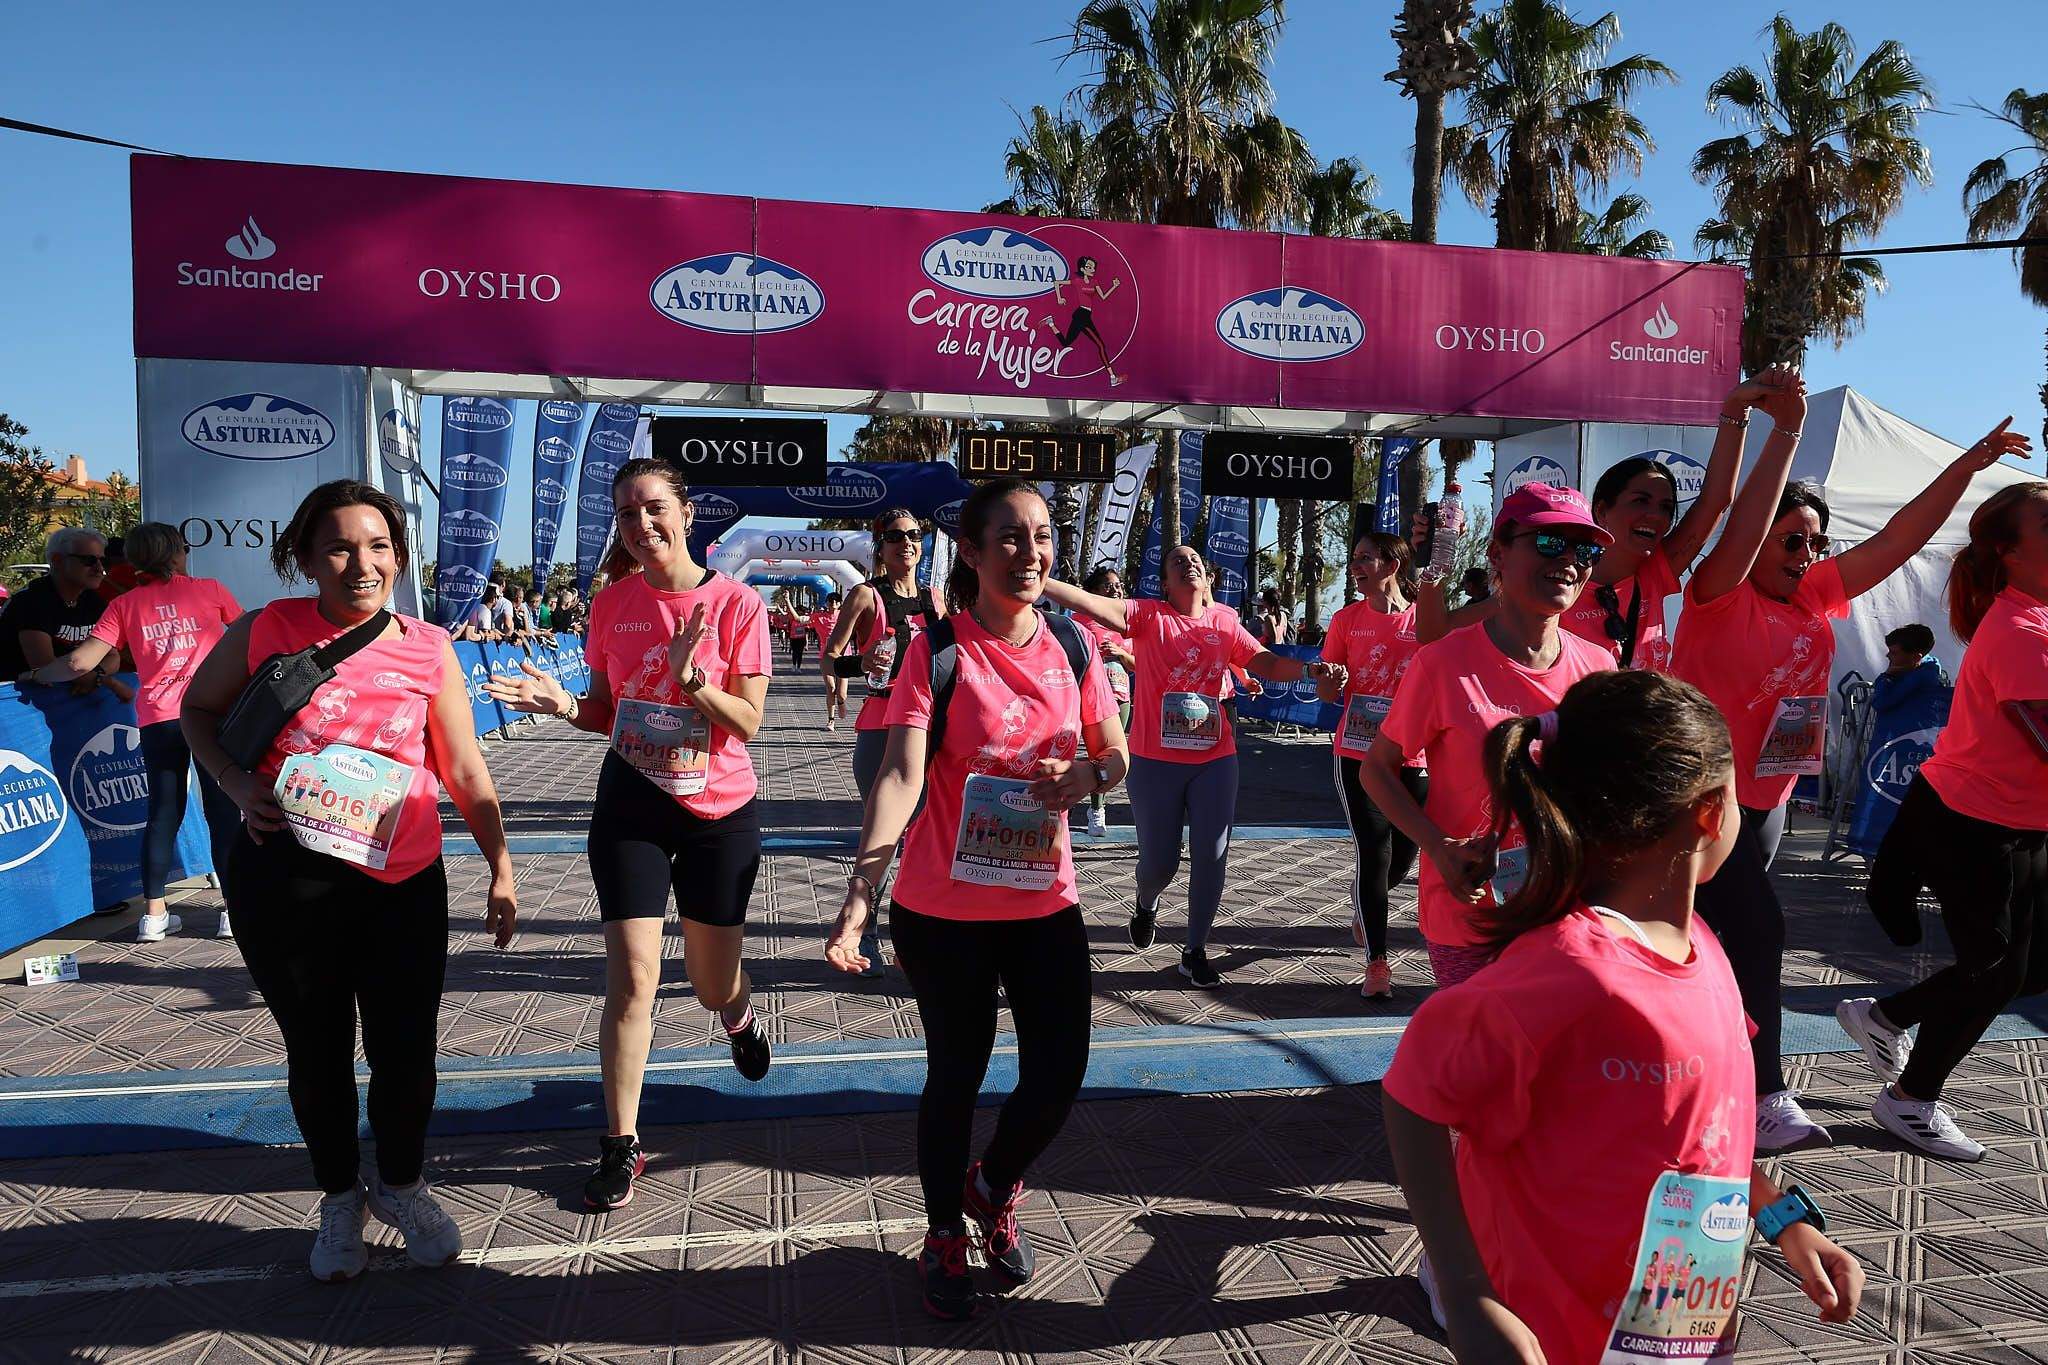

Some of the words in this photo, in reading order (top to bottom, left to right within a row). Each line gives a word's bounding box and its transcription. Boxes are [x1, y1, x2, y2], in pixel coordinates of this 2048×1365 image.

[956, 249, 1003, 260] CENTRAL
[1008, 252, 1054, 262] LECHERA
[177, 262, 324, 292] Santander
[933, 250, 1057, 283] ASTURIANA
[418, 268, 561, 302] OYSHO
[691, 279, 746, 289] CENTRAL
[664, 279, 811, 315] ASTURIANA
[907, 288, 1029, 332] Carrera
[1302, 313, 1350, 323] LECHERA
[1228, 311, 1353, 344] ASTURIANA
[1435, 325, 1545, 354] OYSHO
[937, 329, 960, 355] de
[965, 330, 981, 356] la
[977, 329, 1074, 389] Mujer
[1609, 341, 1709, 365] Santander
[194, 416, 325, 445] ASTURIANA
[217, 415, 266, 425] CENTRAL
[270, 417, 319, 426] LECHERA
[681, 438, 804, 466] OYSHO
[970, 438, 1104, 472] 00:57:11
[1227, 453, 1332, 480] OYSHO
[179, 517, 292, 548] OYSH
[765, 535, 845, 553] OYSHO
[155, 604, 177, 620] TU
[142, 616, 202, 641] DORSAL
[614, 622, 652, 633] OYSHO
[155, 633, 198, 655] SUMA
[956, 672, 1003, 685] OYSHO
[1468, 702, 1521, 716] OYSHO
[642, 742, 680, 761] 016
[95, 761, 132, 774] CENTRAL
[654, 770, 674, 778] MUJER
[0, 776, 47, 796] ECHERA
[82, 768, 149, 812] ASTURI
[320, 789, 366, 817] 016
[324, 813, 348, 827] 3843
[307, 819, 319, 829] DE
[319, 821, 329, 831] LA
[329, 824, 353, 839] MUJER
[356, 833, 383, 849] VALENCIA
[1000, 827, 1037, 847] 016
[341, 844, 374, 861] Santander
[961, 853, 991, 865] CARRERA
[992, 857, 1001, 866] DE
[1001, 860, 1010, 868] LA
[1010, 861, 1028, 869] MUJER
[1032, 863, 1056, 871] VALENCIA
[965, 867, 1003, 881] OYSHO
[1602, 1055, 1704, 1085] OYSHO
[1661, 1194, 1693, 1210] SUMA
[1686, 1275, 1738, 1311] 016
[1689, 1320, 1716, 1336] 6148
[1621, 1336, 1669, 1355] CARRERA
[1669, 1342, 1682, 1355] DE
[1681, 1342, 1694, 1355] LA
